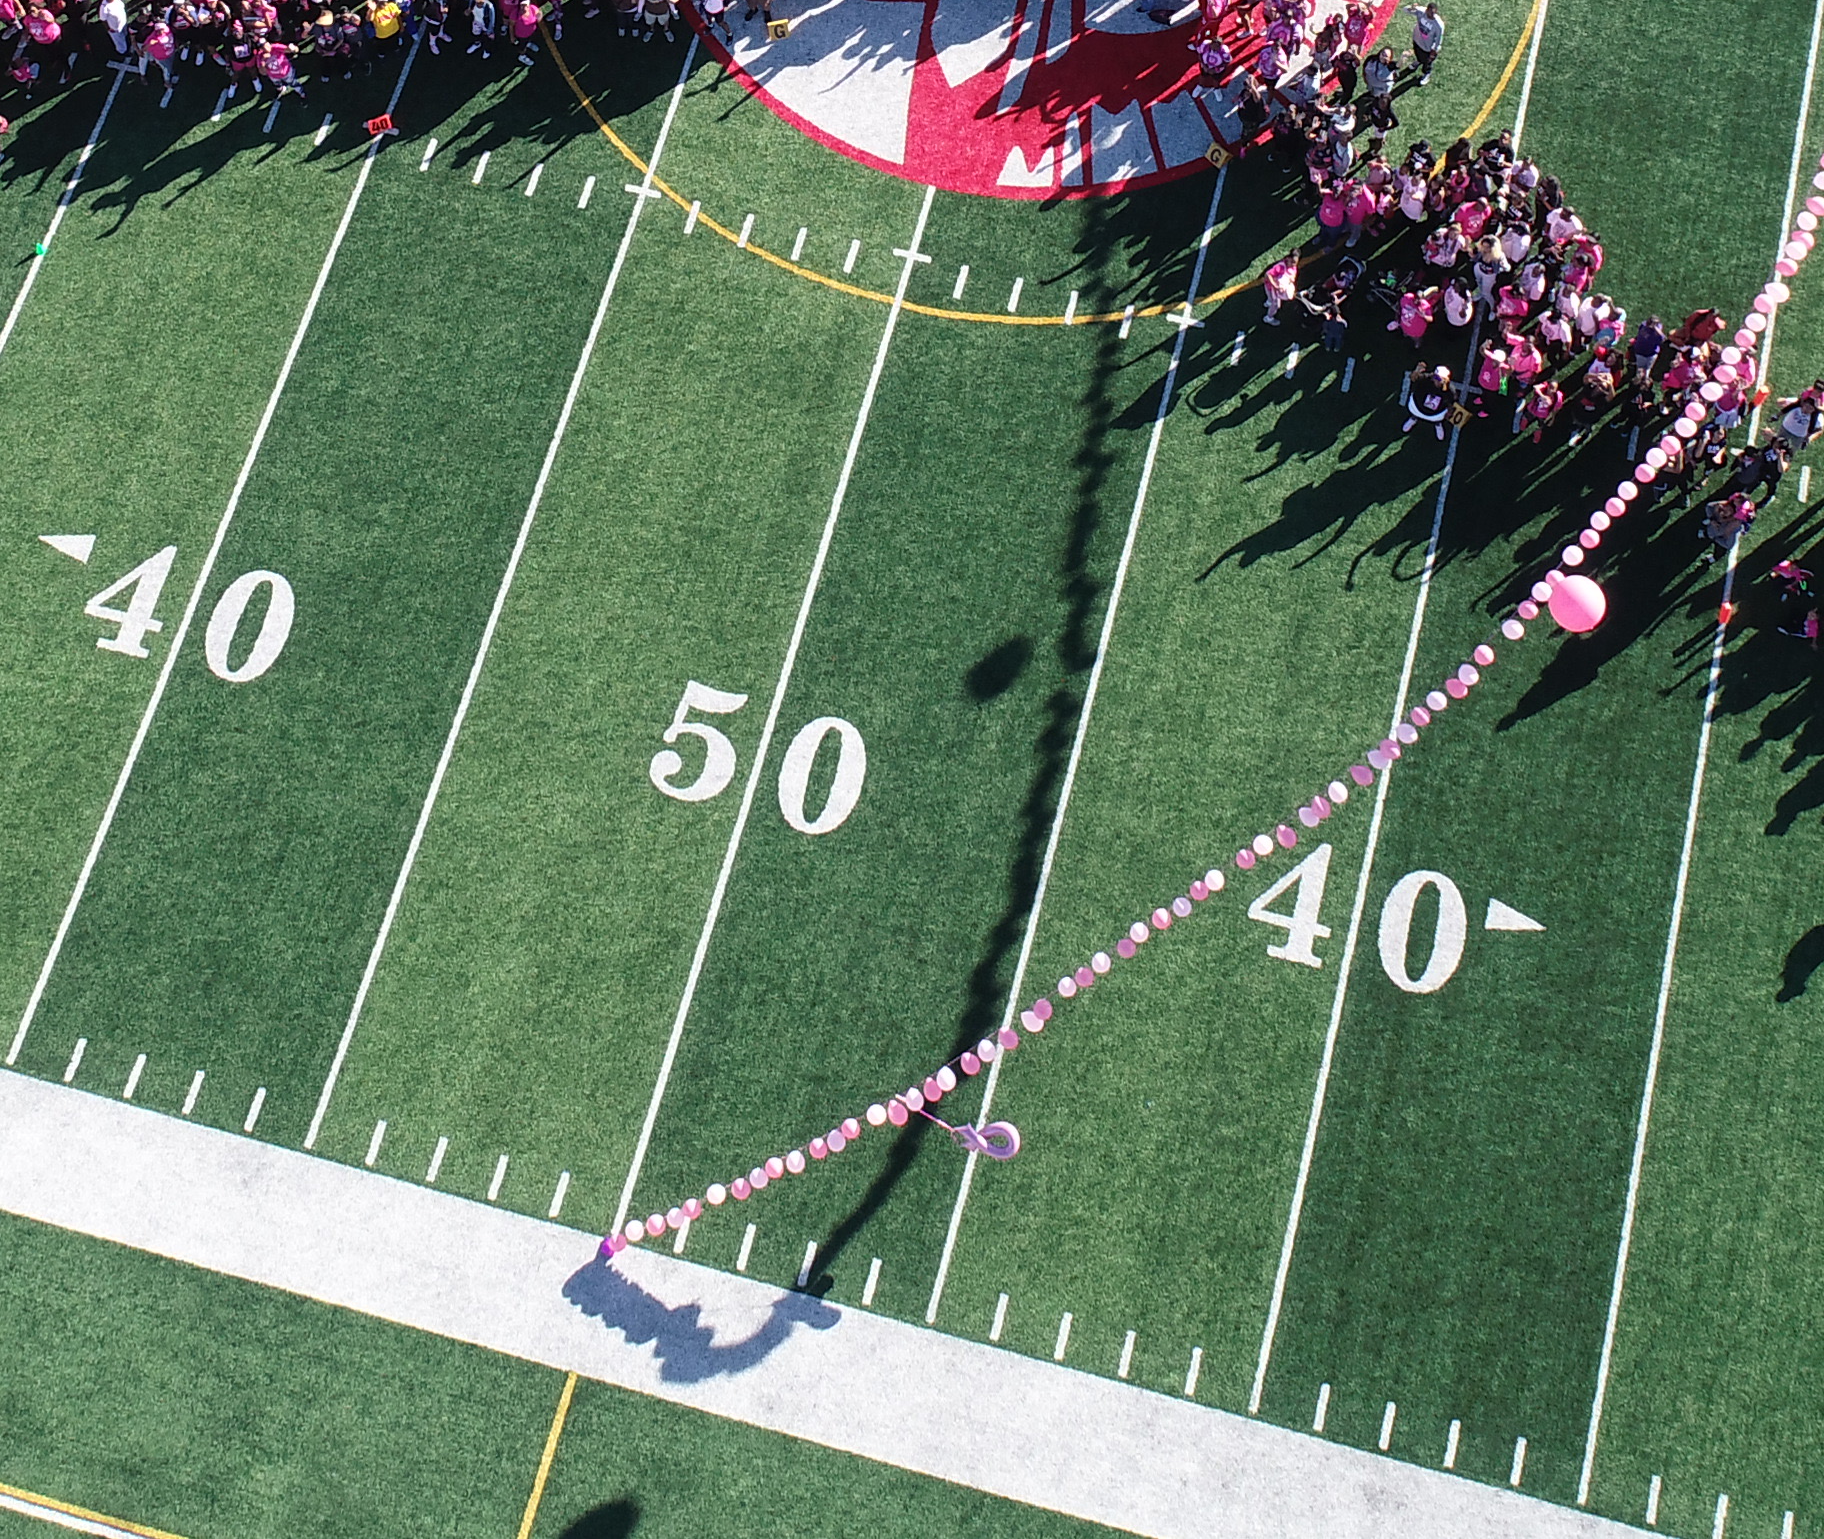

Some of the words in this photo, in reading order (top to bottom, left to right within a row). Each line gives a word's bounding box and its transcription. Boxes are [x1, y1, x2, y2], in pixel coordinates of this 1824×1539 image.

[84, 545, 295, 682] 40
[649, 680, 866, 834] 50
[1248, 843, 1467, 993] 40
